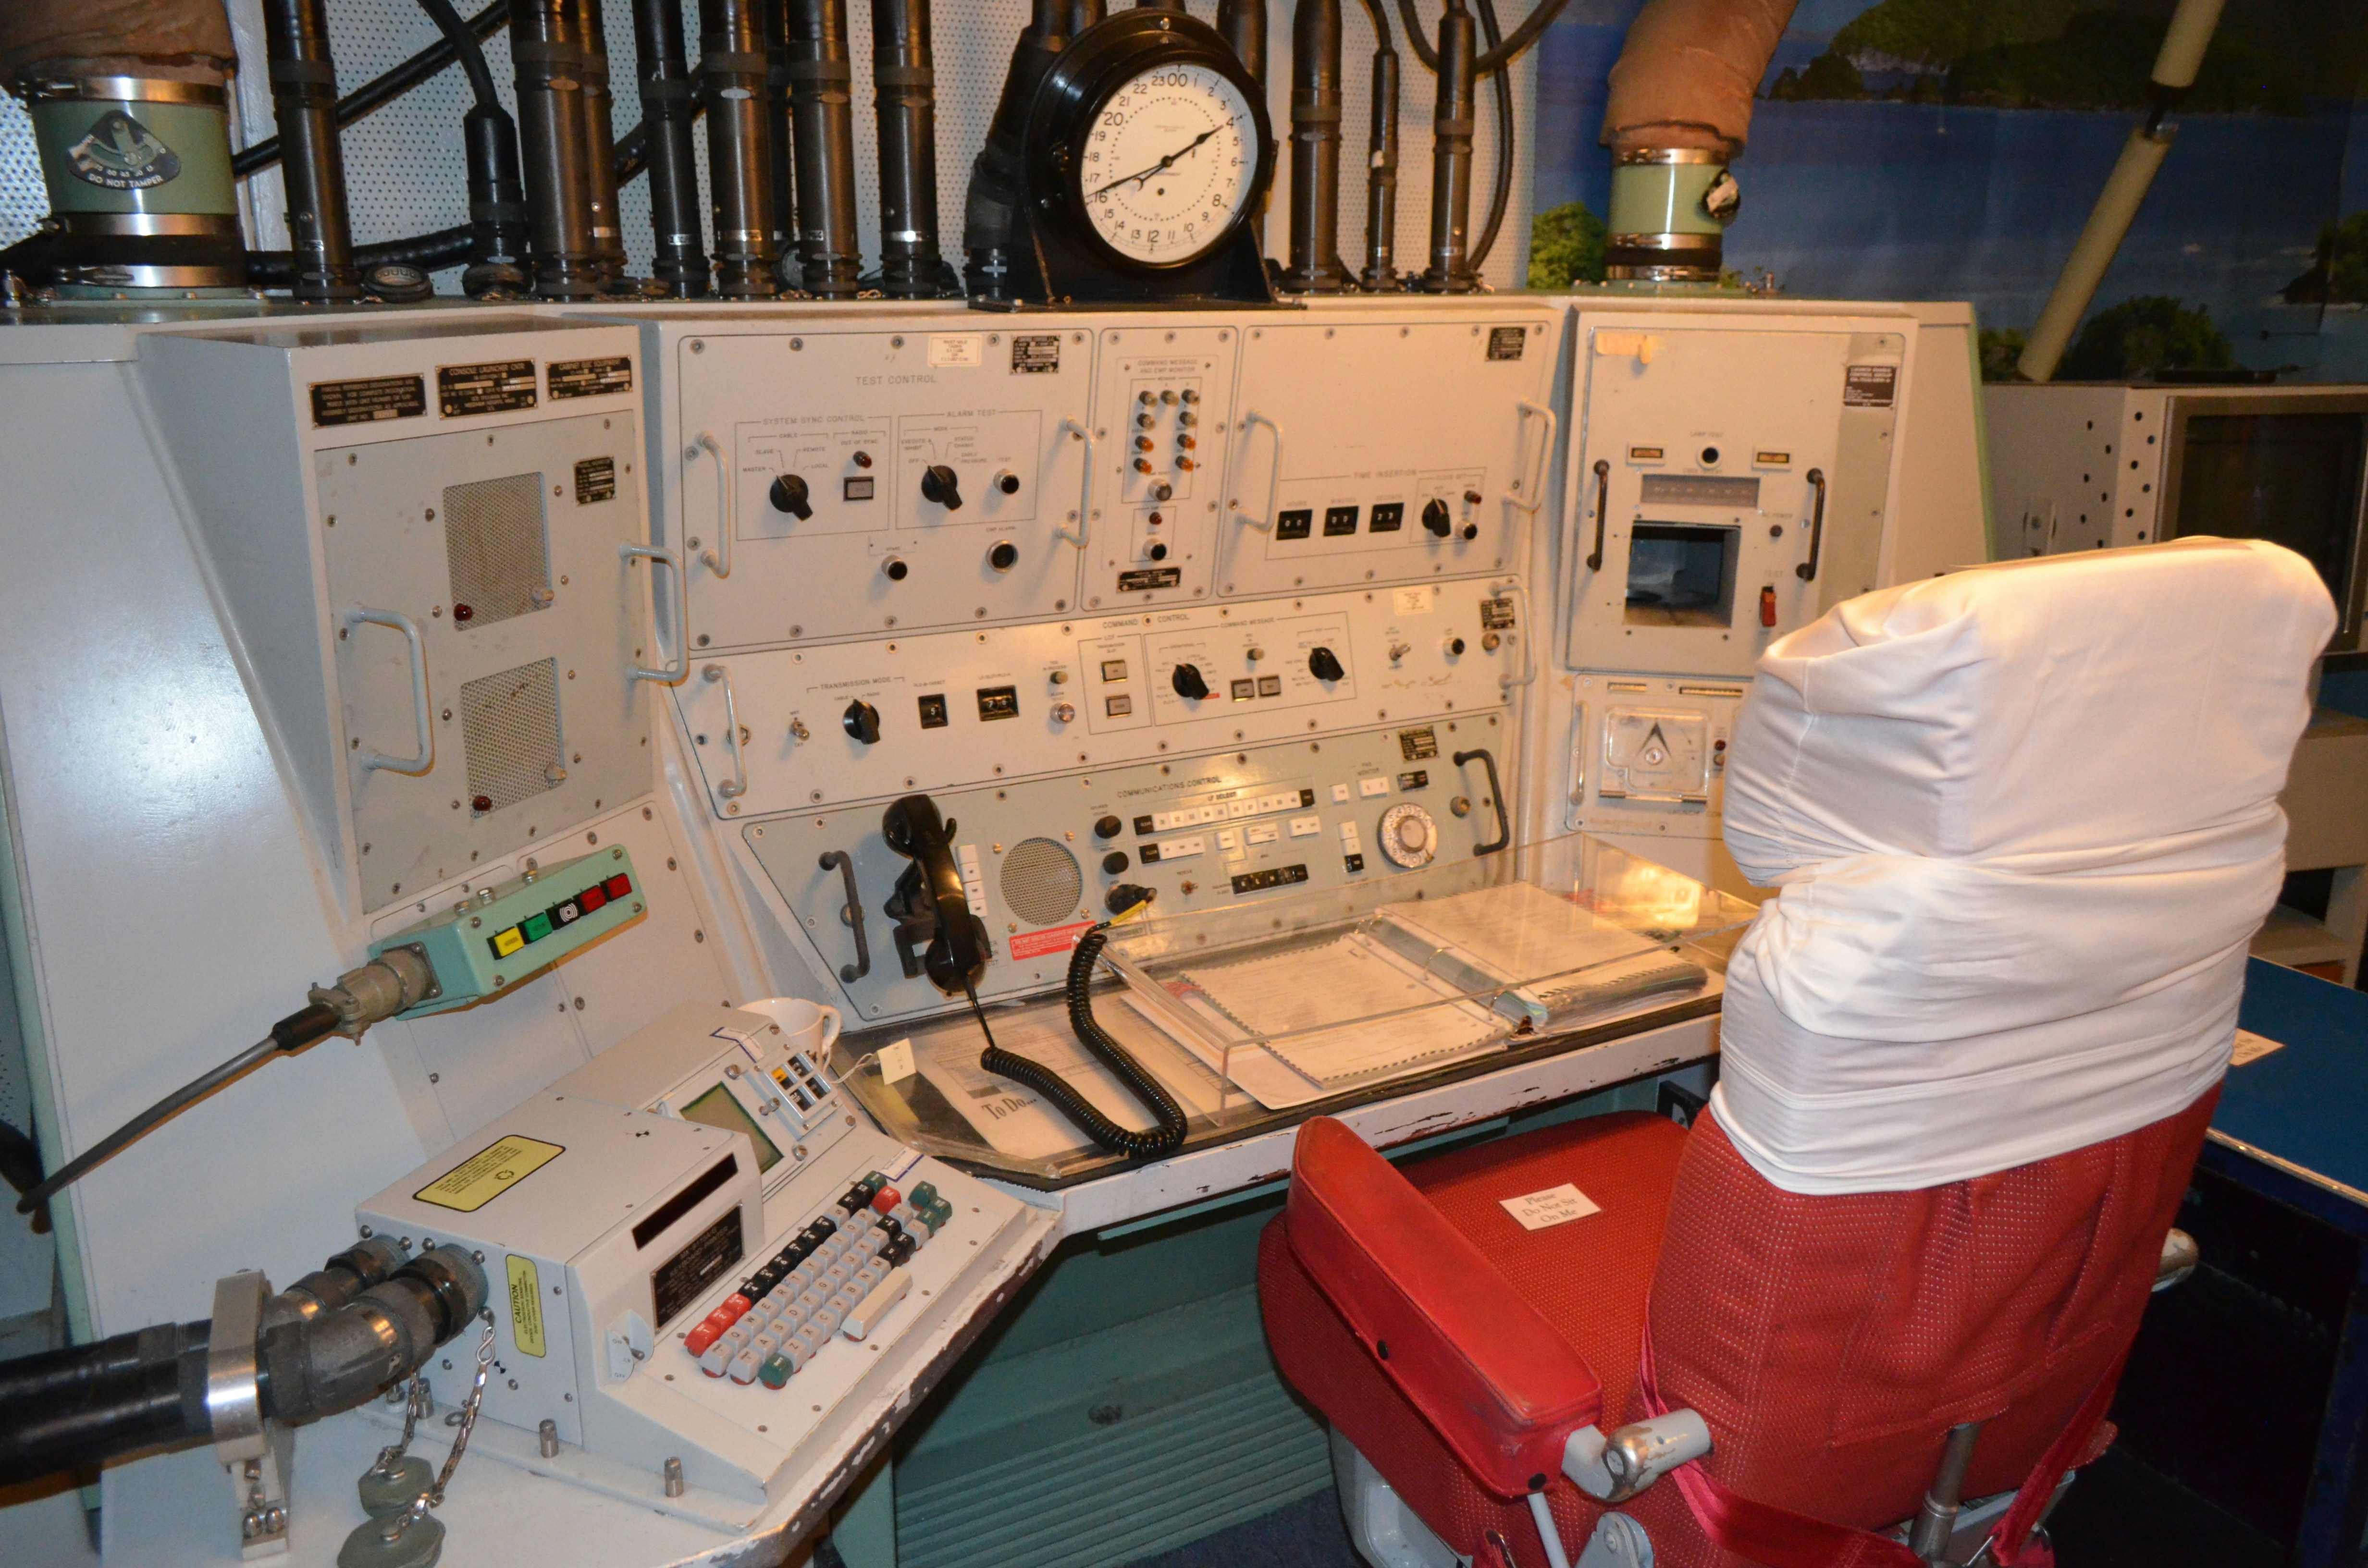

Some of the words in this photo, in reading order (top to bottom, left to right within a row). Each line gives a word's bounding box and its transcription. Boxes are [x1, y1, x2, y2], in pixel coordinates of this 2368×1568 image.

[1152, 75, 1165, 86] 23
[1167, 73, 1188, 87] 00
[1194, 77, 1197, 87] 1
[1133, 84, 1147, 94] 22
[1208, 86, 1214, 97] 2
[1119, 96, 1130, 106] 21
[1220, 100, 1226, 110] 3
[1104, 112, 1123, 126] 20
[1226, 116, 1234, 129] 4
[1095, 131, 1106, 141] 19
[1233, 136, 1239, 146] 5
[1089, 152, 1099, 162] 18
[1231, 157, 1237, 167] 6
[88, 173, 103, 184] DO
[106, 179, 125, 188] NOT
[129, 175, 163, 188] TAMPER
[1089, 172, 1100, 183] 17
[1226, 179, 1233, 188] 7
[1094, 189, 1108, 203] 16
[1212, 194, 1221, 207] 8
[1105, 208, 1114, 218] 15
[1201, 212, 1209, 221] 9
[1115, 220, 1124, 230] 14
[1184, 222, 1194, 232] 10
[1131, 230, 1141, 239] 13
[1147, 230, 1160, 243] 12
[1168, 231, 1175, 239] 11
[449, 367, 477, 376] CONSOLE
[479, 365, 508, 373] LAUNCHER
[855, 376, 883, 385] TEST
[888, 374, 937, 384] CONTROL
[1375, 470, 1417, 478] INSERTION
[1102, 619, 1138, 628] COMMAND
[1158, 614, 1189, 623] CONTROL
[820, 678, 870, 690] TRANSMISSION
[872, 675, 891, 684] MODE
[1117, 782, 1185, 798] COMMUNICATIONS
[1188, 776, 1221, 787] CONTROL
[981, 1103, 1007, 1119] To
[1002, 1098, 1036, 1112] Do...
[1525, 1193, 1556, 1205] Please
[1522, 1207, 1540, 1216] Do
[1541, 1202, 1562, 1211] Not
[511, 1284, 522, 1323] CAUTION
